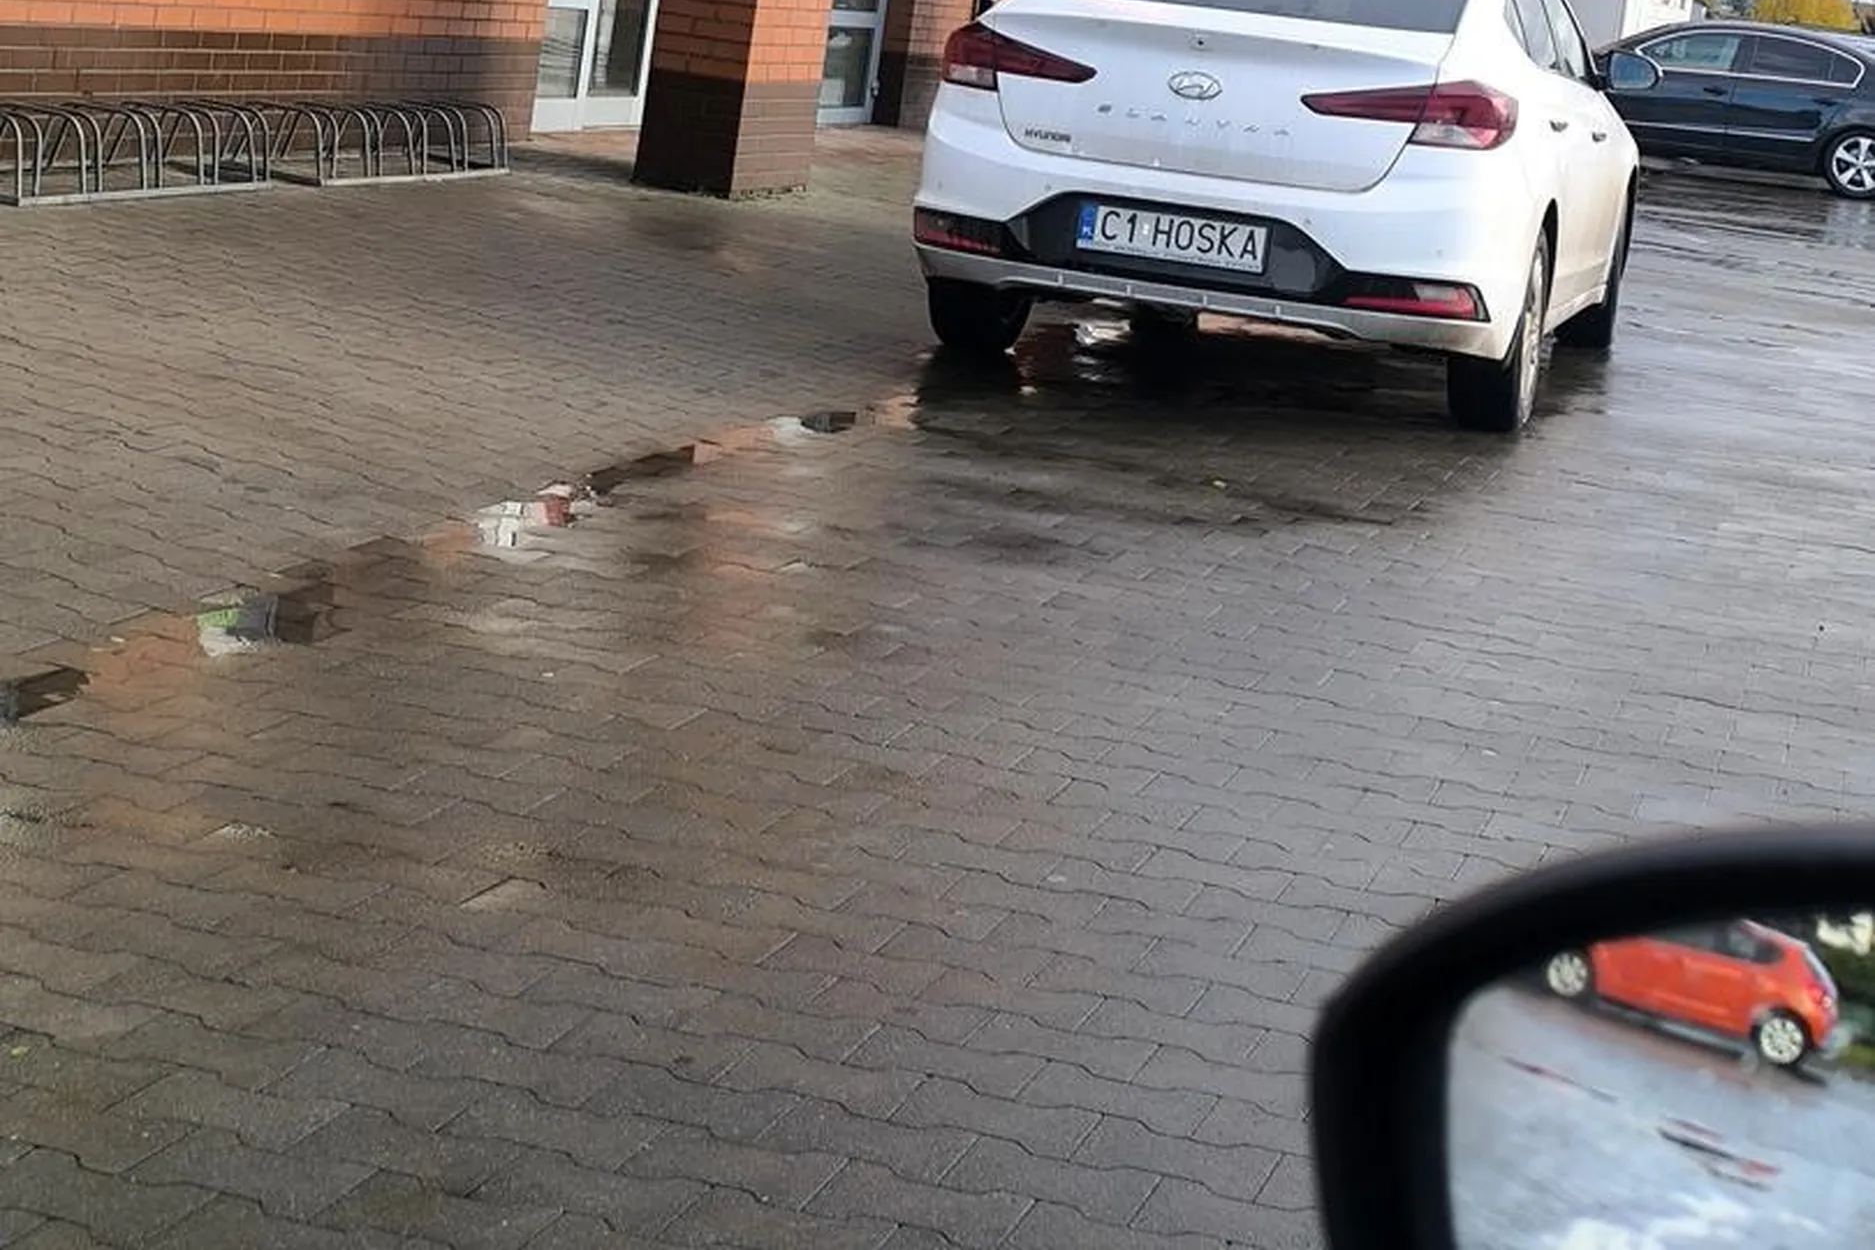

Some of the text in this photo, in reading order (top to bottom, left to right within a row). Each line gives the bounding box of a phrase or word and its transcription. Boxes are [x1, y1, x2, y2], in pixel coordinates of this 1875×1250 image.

[1024, 127, 1072, 143] HYUNDAI
[1101, 210, 1138, 244] C1
[1152, 215, 1258, 261] HOSKA
